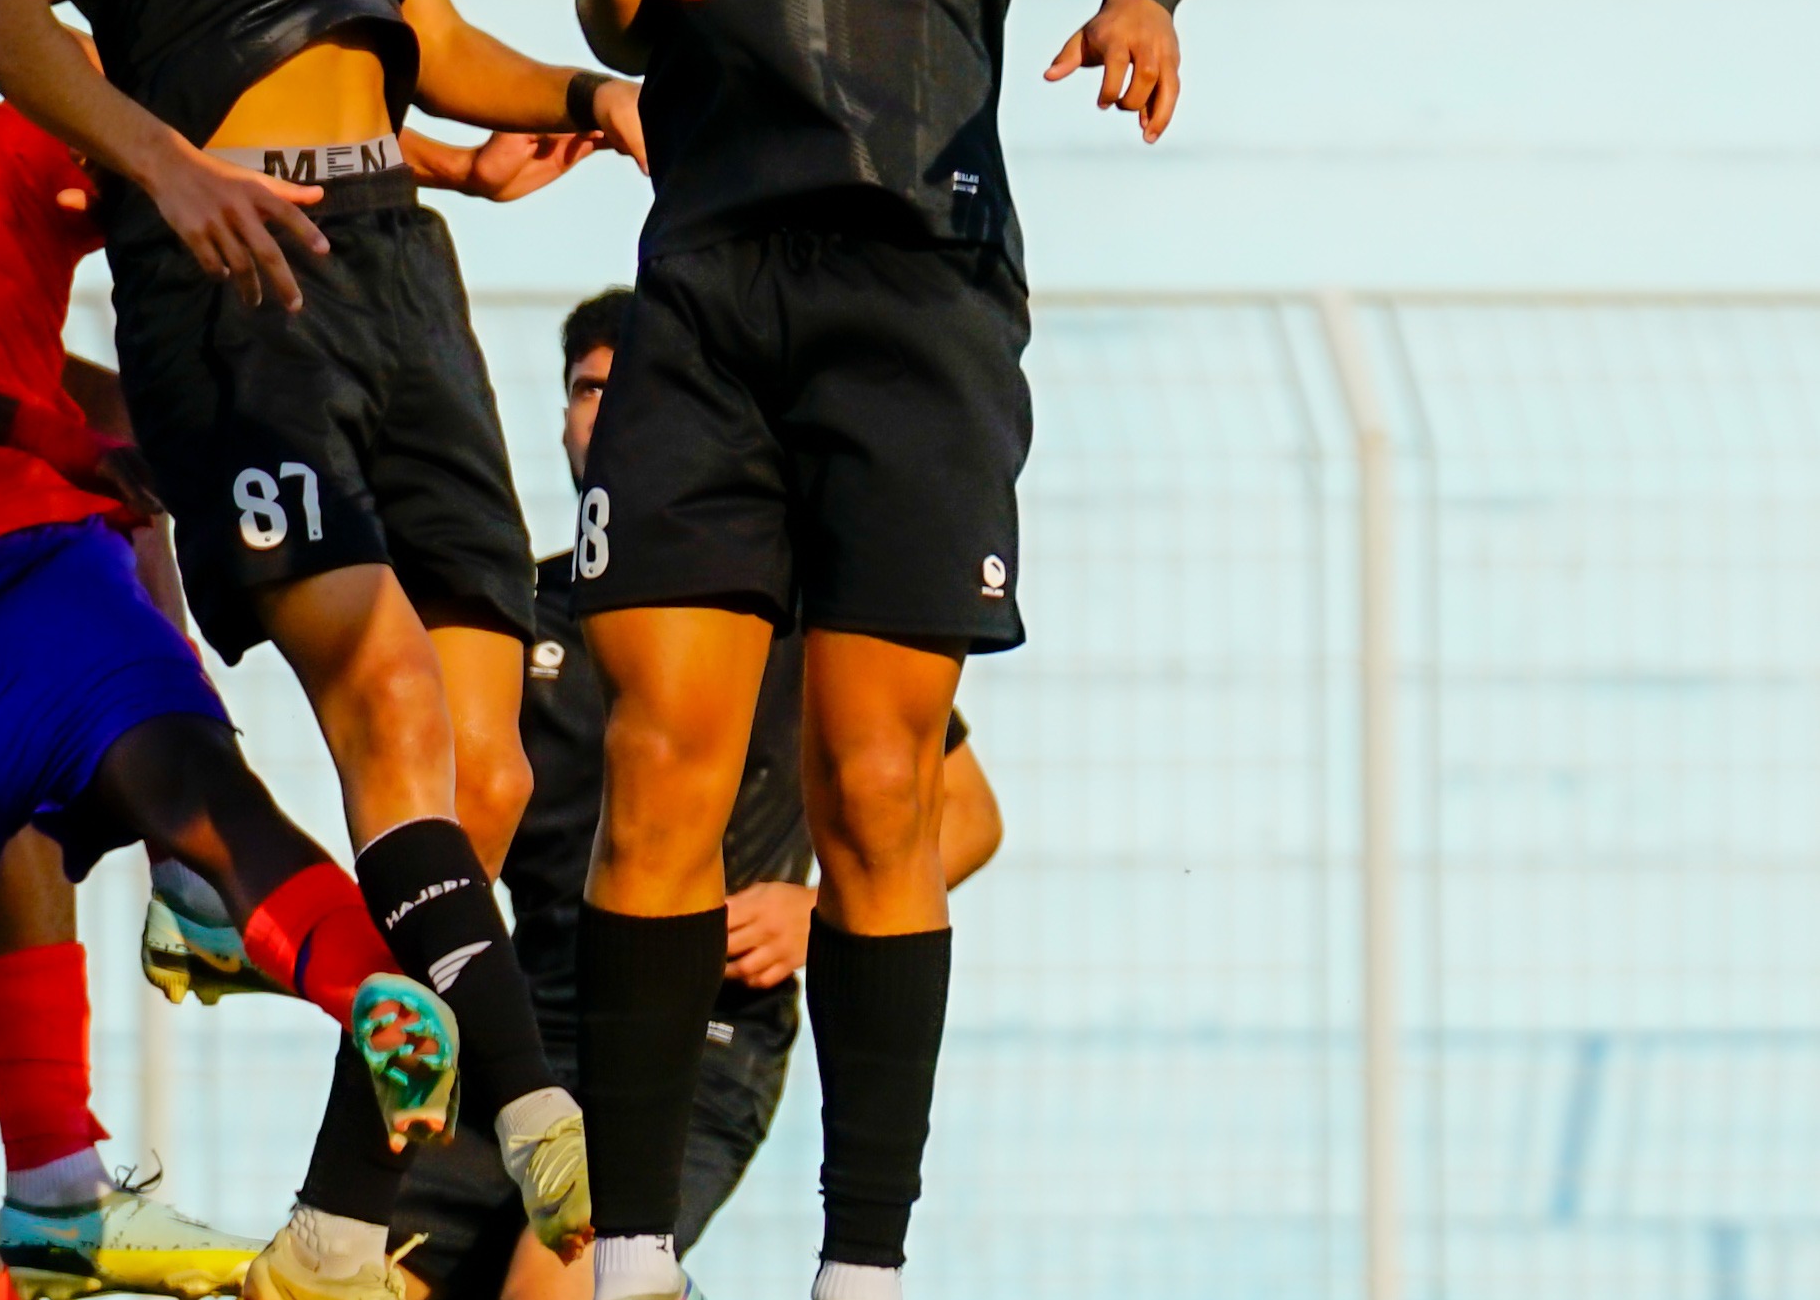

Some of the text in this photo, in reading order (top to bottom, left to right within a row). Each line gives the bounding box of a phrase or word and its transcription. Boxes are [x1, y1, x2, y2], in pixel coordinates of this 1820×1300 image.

[264, 140, 387, 181] MEN
[232, 461, 324, 550] 87
[571, 487, 611, 583] 8
